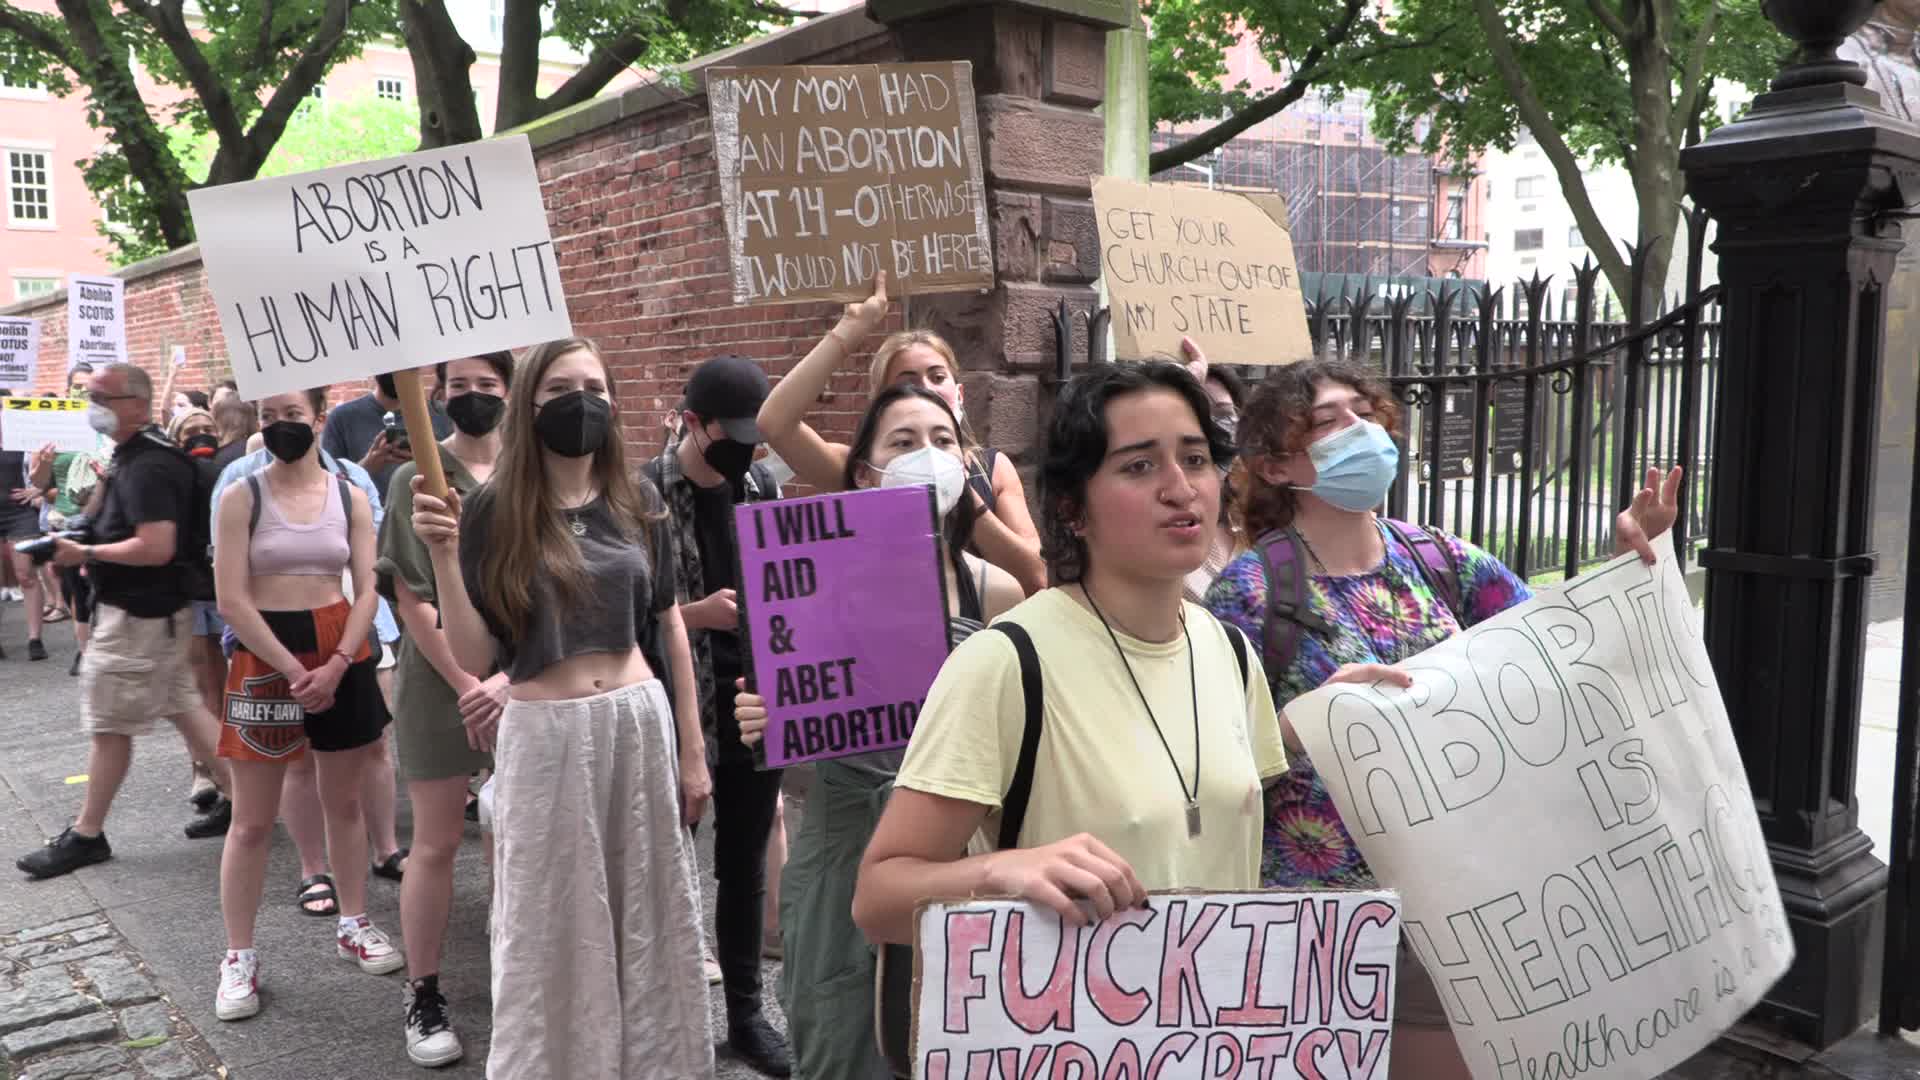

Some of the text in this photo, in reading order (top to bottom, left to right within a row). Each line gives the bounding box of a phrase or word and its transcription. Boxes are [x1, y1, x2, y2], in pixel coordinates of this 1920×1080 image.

[735, 72, 950, 119] MY MOM HAD
[741, 126, 962, 174] AN ABORTION
[293, 156, 483, 253] ABORTION
[742, 189, 779, 238] AT
[788, 186, 828, 237] 14
[1106, 207, 1235, 247] GET YOUR
[364, 236, 420, 263] IS A
[842, 242, 880, 286] NOT
[892, 239, 917, 279] BE
[923, 232, 982, 275] HERE
[1106, 244, 1292, 291] CHURCH OUT OF
[79, 305, 115, 321] SCOTUS
[90, 325, 105, 337] NOT
[235, 241, 554, 372] HUMAN RIGHT
[1125, 294, 1254, 336] MY STATE
[754, 499, 855, 549] I WILL
[763, 557, 817, 602] AID
[769, 614, 796, 655] &
[776, 657, 857, 707] ABET
[783, 698, 924, 760] ABORTIO
[1577, 738, 1661, 831] IS
[943, 898, 1395, 1034] FUCKING
[1484, 987, 1705, 1080] Healthcare
